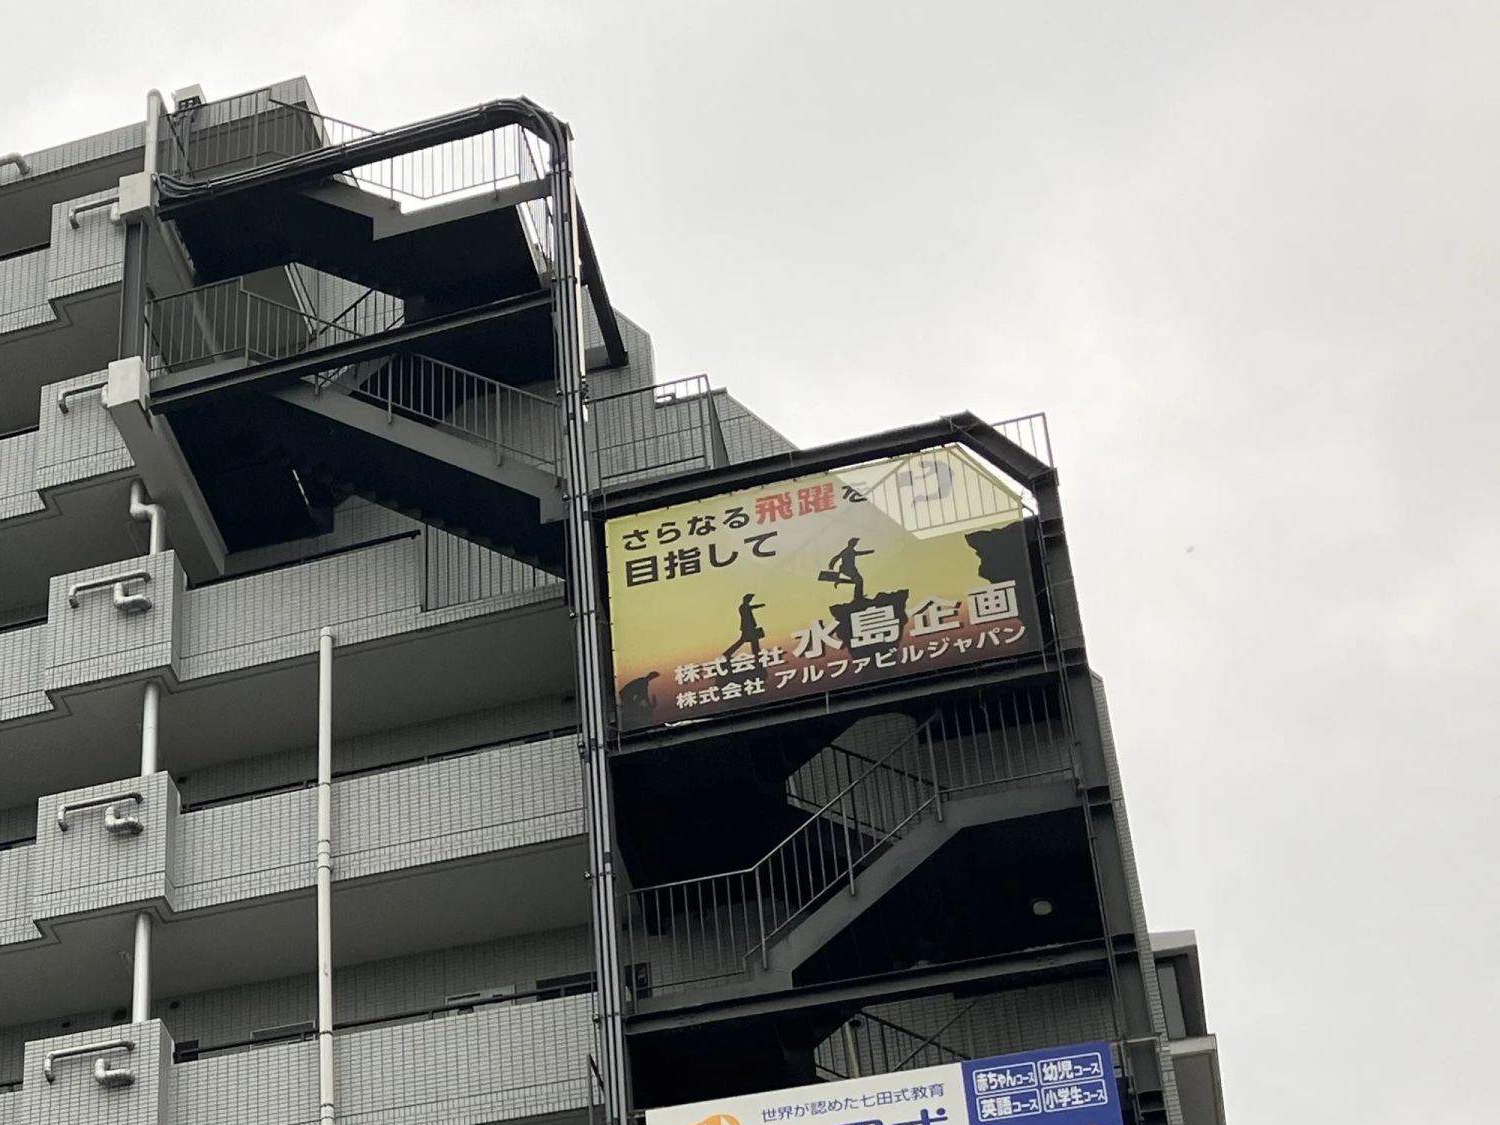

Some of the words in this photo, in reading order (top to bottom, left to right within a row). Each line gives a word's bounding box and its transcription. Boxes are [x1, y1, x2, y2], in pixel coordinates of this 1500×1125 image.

[625, 530, 779, 588] 目指して
[674, 646, 787, 686] 株式会社
[789, 580, 1020, 660] 水島企画
[675, 677, 767, 710] 株式会社
[774, 625, 1026, 690] アルファビルジャパン
[976, 1069, 1036, 1092] 赤ちゃんコース
[1042, 1060, 1101, 1082] 幼児コース
[762, 1083, 945, 1122] 世界が認めた七田式教育
[980, 1096, 1040, 1118] 英語コース
[1046, 1086, 1106, 1109] 小学生コース
